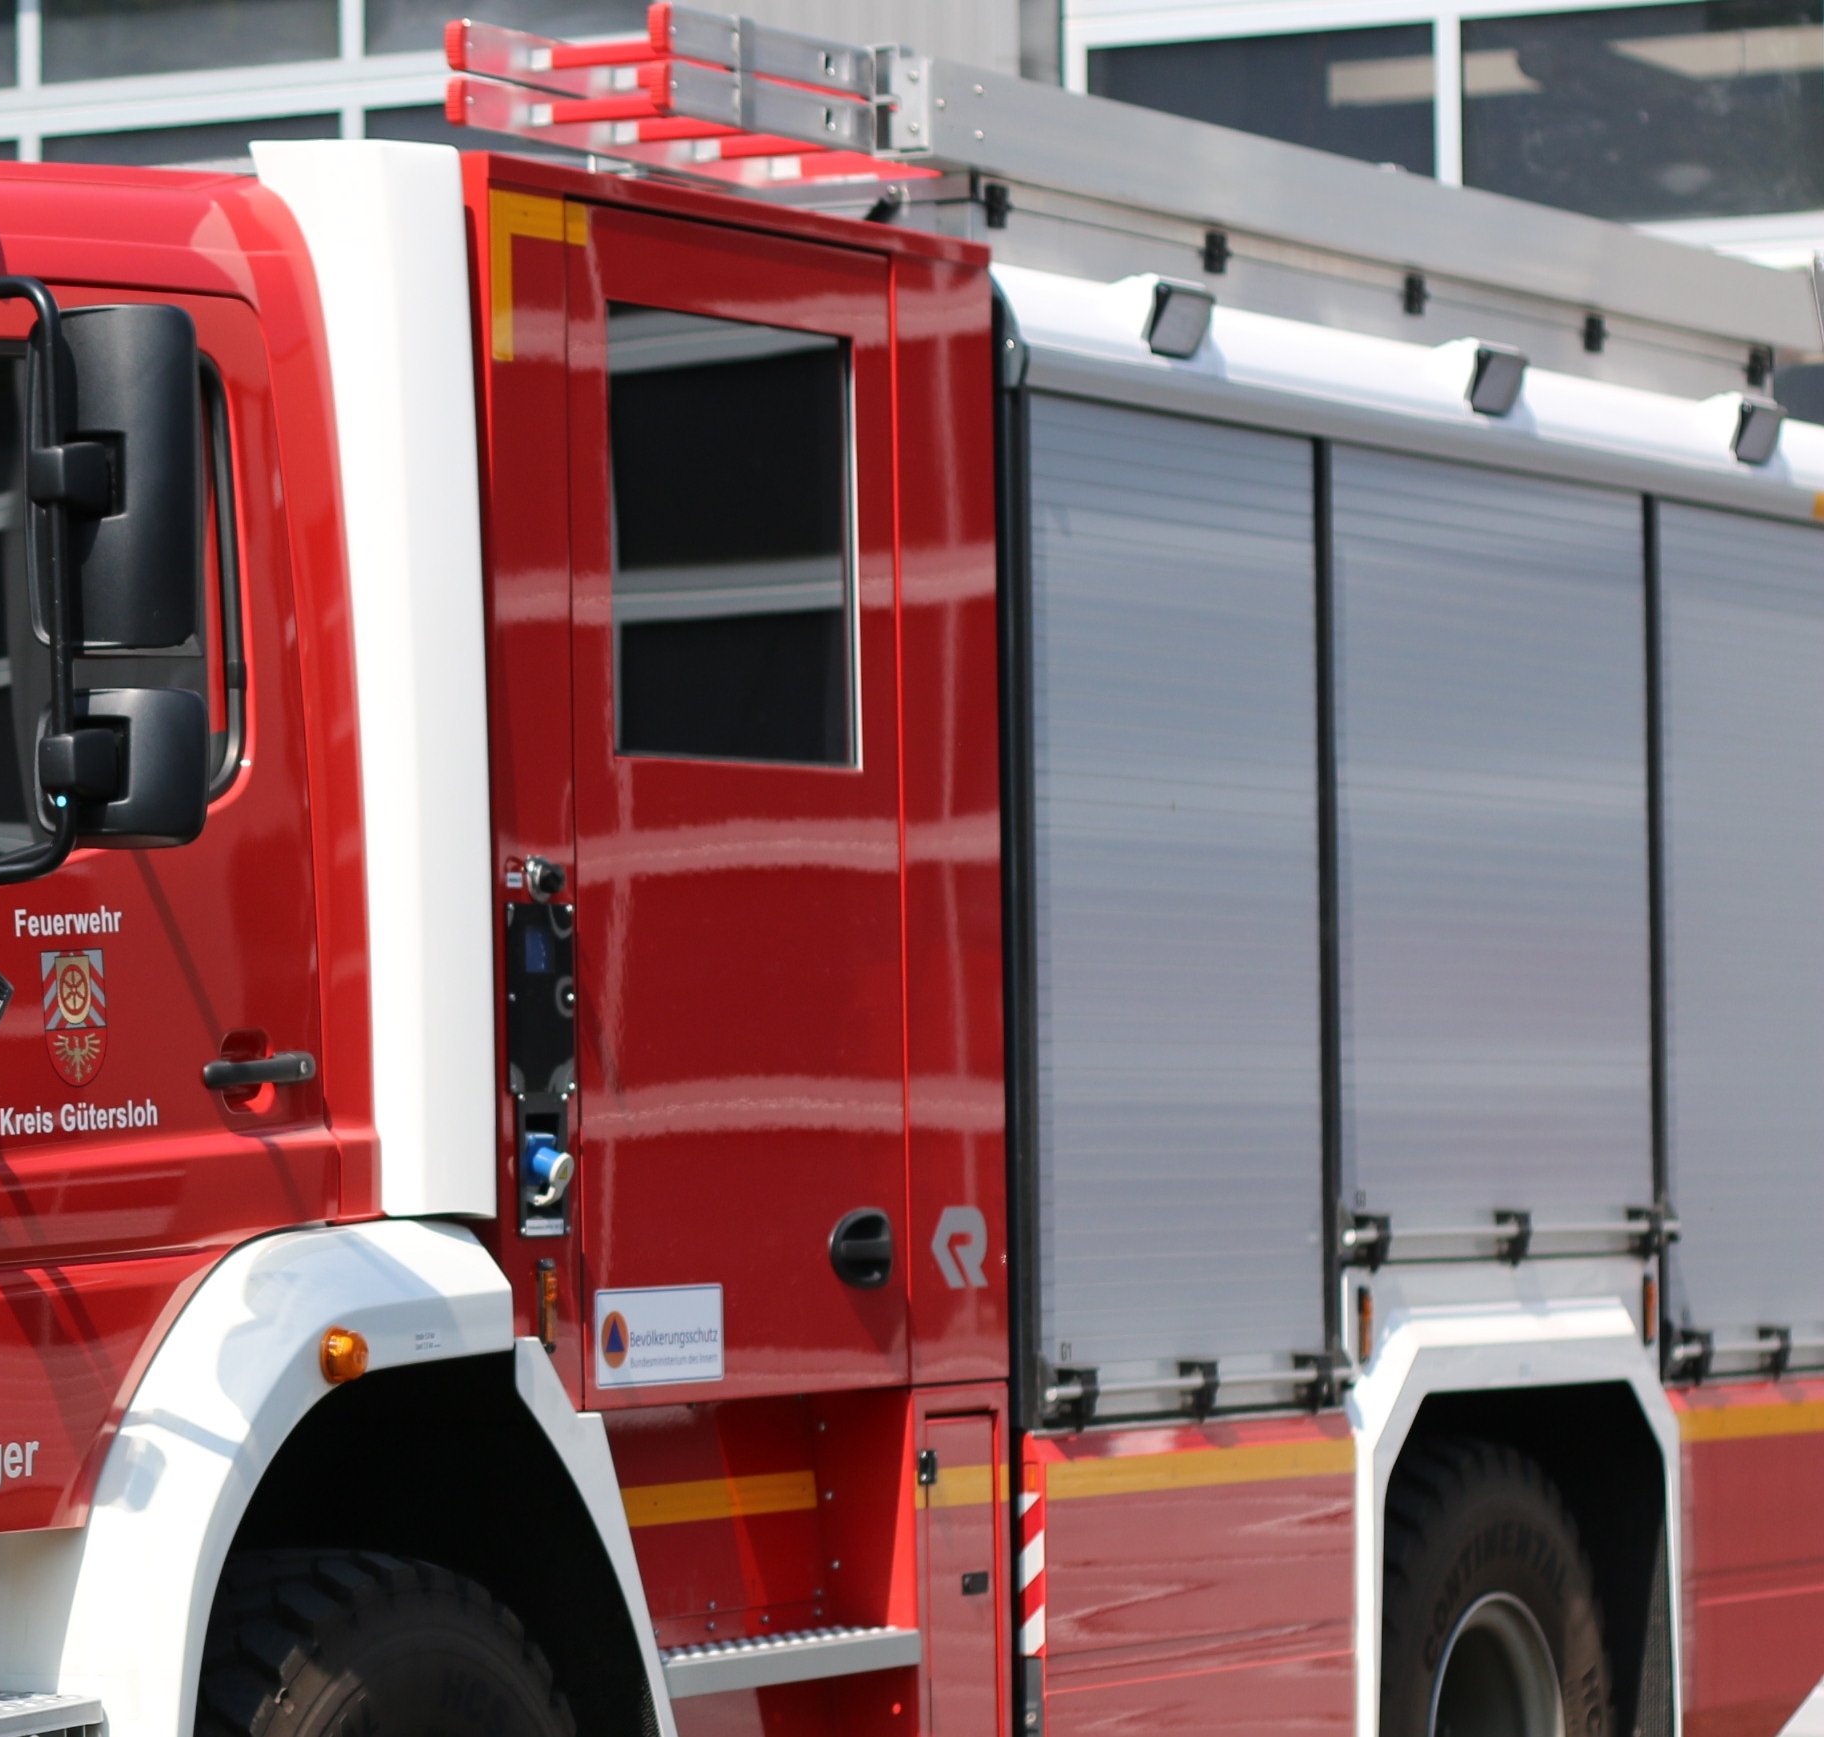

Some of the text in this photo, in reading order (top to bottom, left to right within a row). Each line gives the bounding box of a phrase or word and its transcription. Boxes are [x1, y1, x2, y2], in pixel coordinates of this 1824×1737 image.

[14, 906, 122, 937] Feuerwehr
[0, 1098, 159, 1136] Kreis Gütersloh
[630, 1327, 718, 1348] Bevölkerungsschutz
